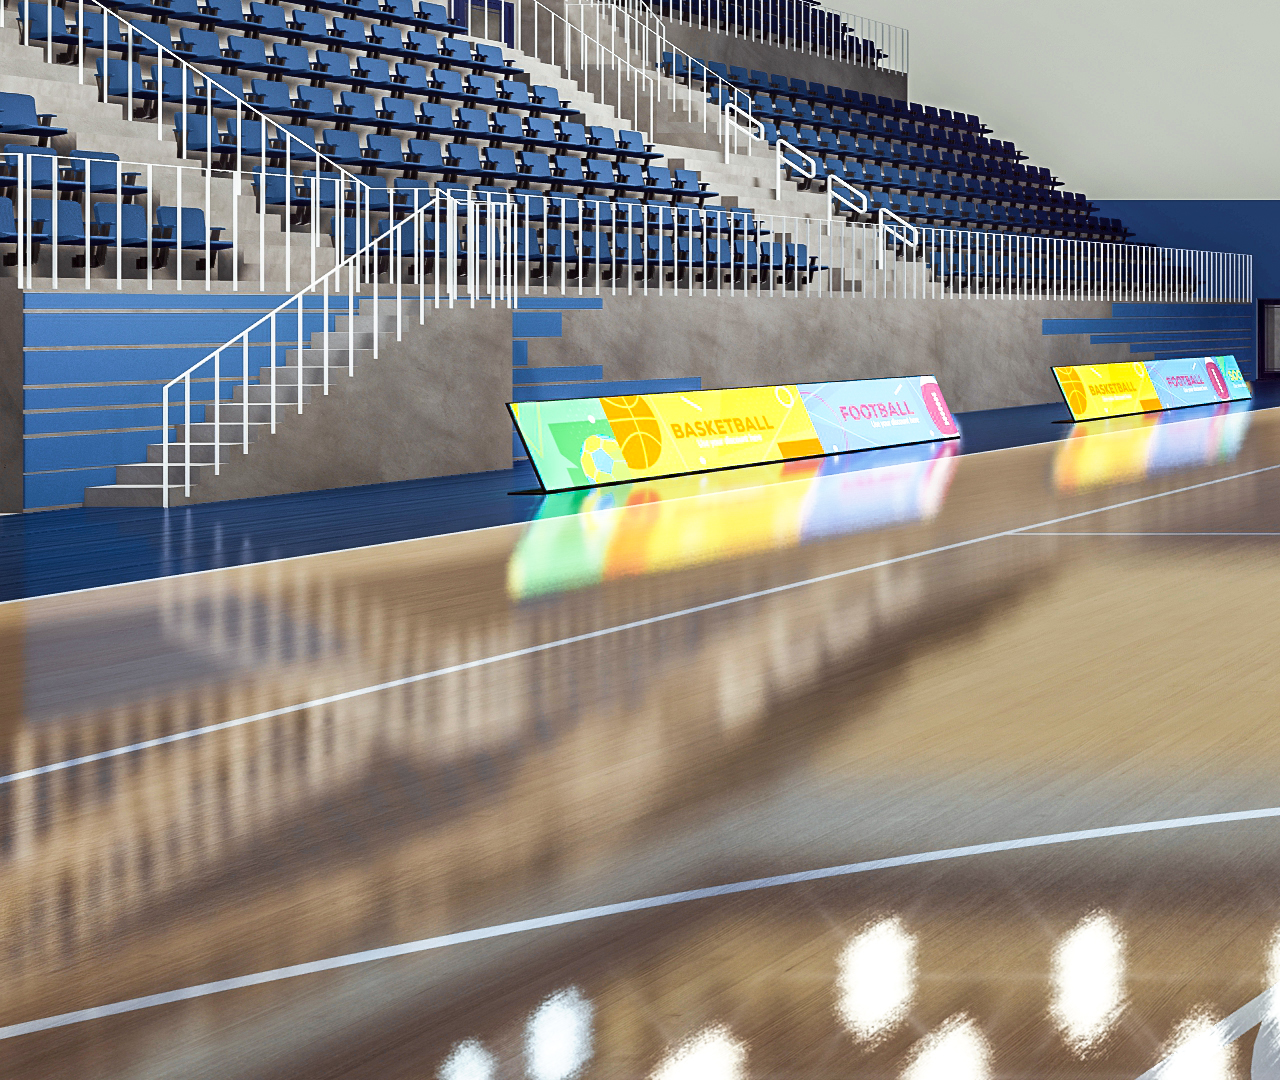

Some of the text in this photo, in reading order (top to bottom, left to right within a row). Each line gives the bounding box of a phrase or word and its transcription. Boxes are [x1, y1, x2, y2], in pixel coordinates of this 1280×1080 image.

[1089, 382, 1137, 396] BASKETBALL
[839, 400, 914, 421] FOOTBALL
[670, 416, 774, 438] BASKETBALL
